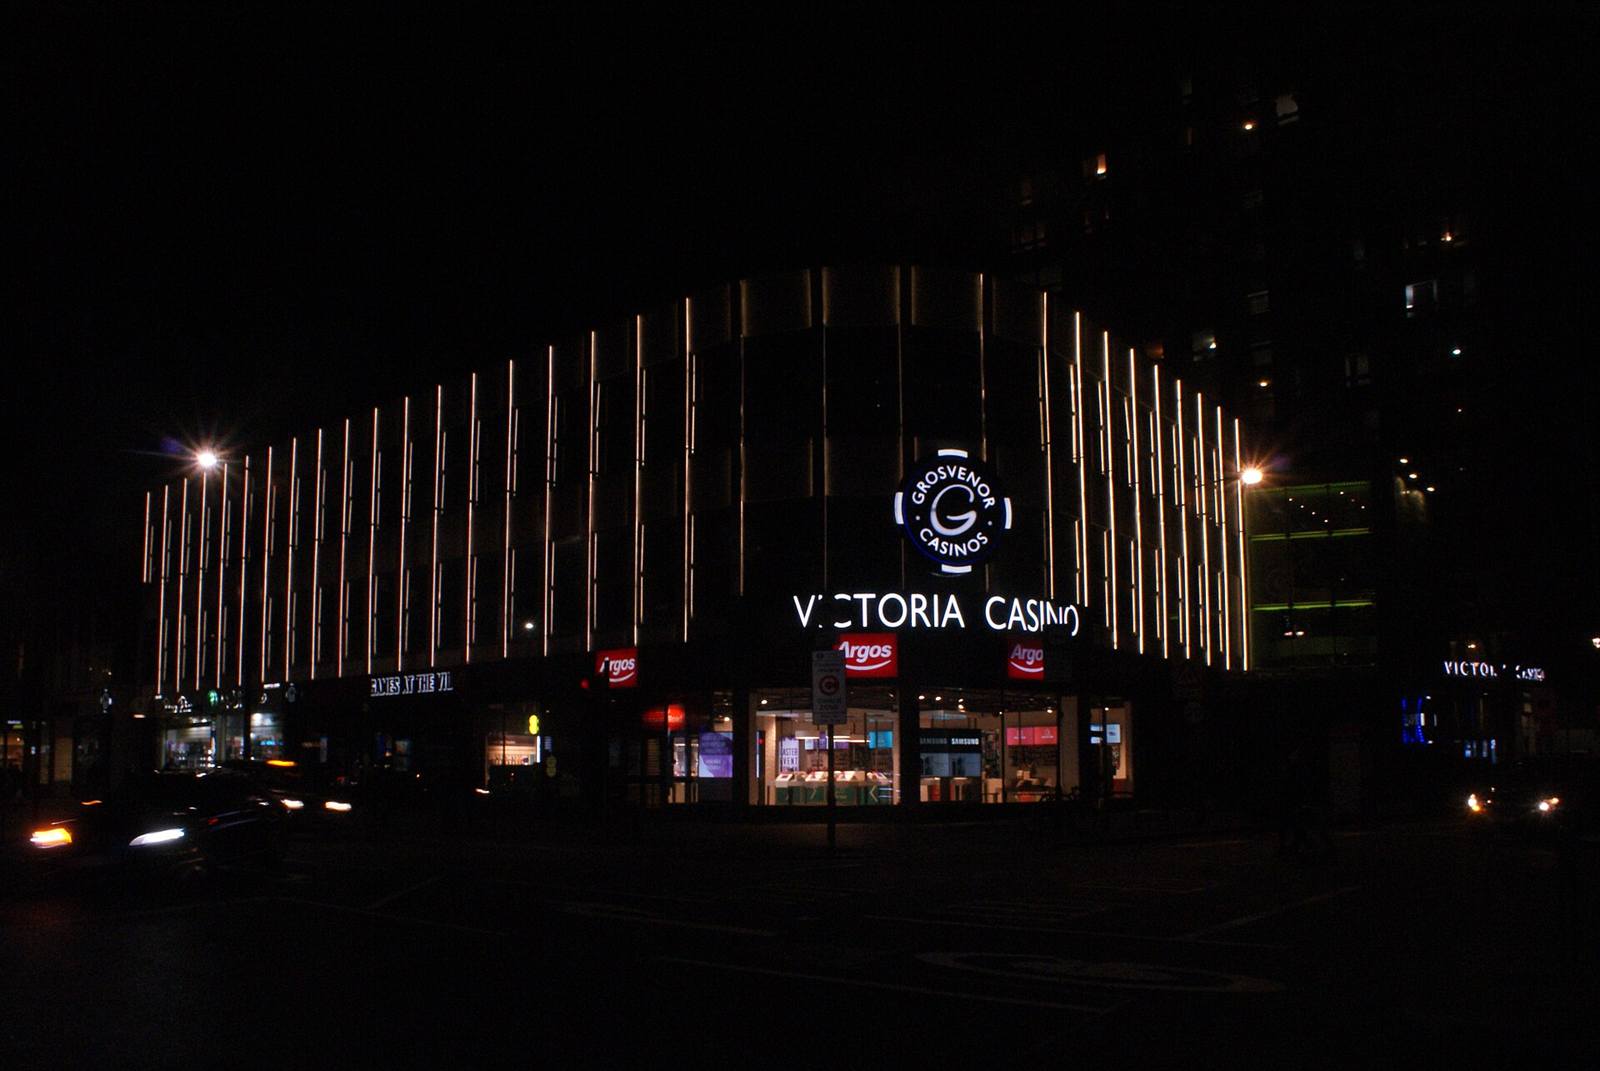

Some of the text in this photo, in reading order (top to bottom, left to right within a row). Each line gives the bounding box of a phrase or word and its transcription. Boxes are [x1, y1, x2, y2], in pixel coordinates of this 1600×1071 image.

[911, 464, 995, 509] GROSVENOR
[930, 484, 977, 536] G
[920, 531, 988, 557] CASINOS
[793, 592, 965, 628] VCTORIA
[838, 640, 893, 663] Argos
[1010, 643, 1044, 665] Argo
[416, 673, 435, 693] THE
[951, 737, 979, 745] SAMSUNG
